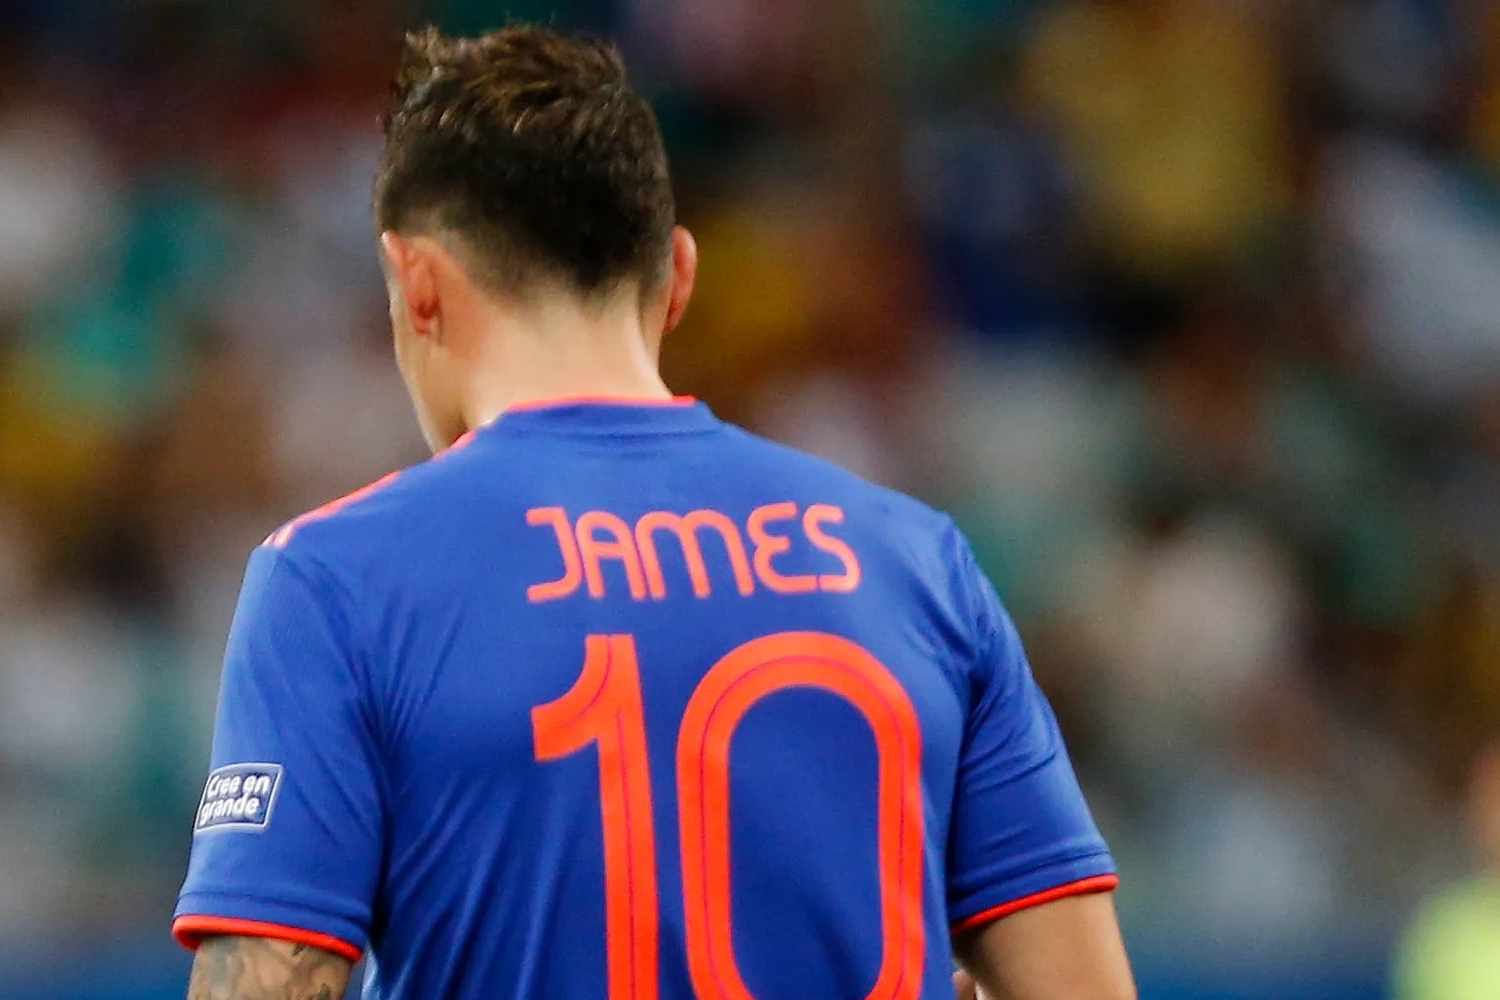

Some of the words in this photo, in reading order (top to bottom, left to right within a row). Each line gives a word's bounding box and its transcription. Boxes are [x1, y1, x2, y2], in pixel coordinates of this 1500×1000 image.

[527, 502, 862, 601] JAMES
[242, 775, 271, 795] en
[199, 792, 260, 827] grande
